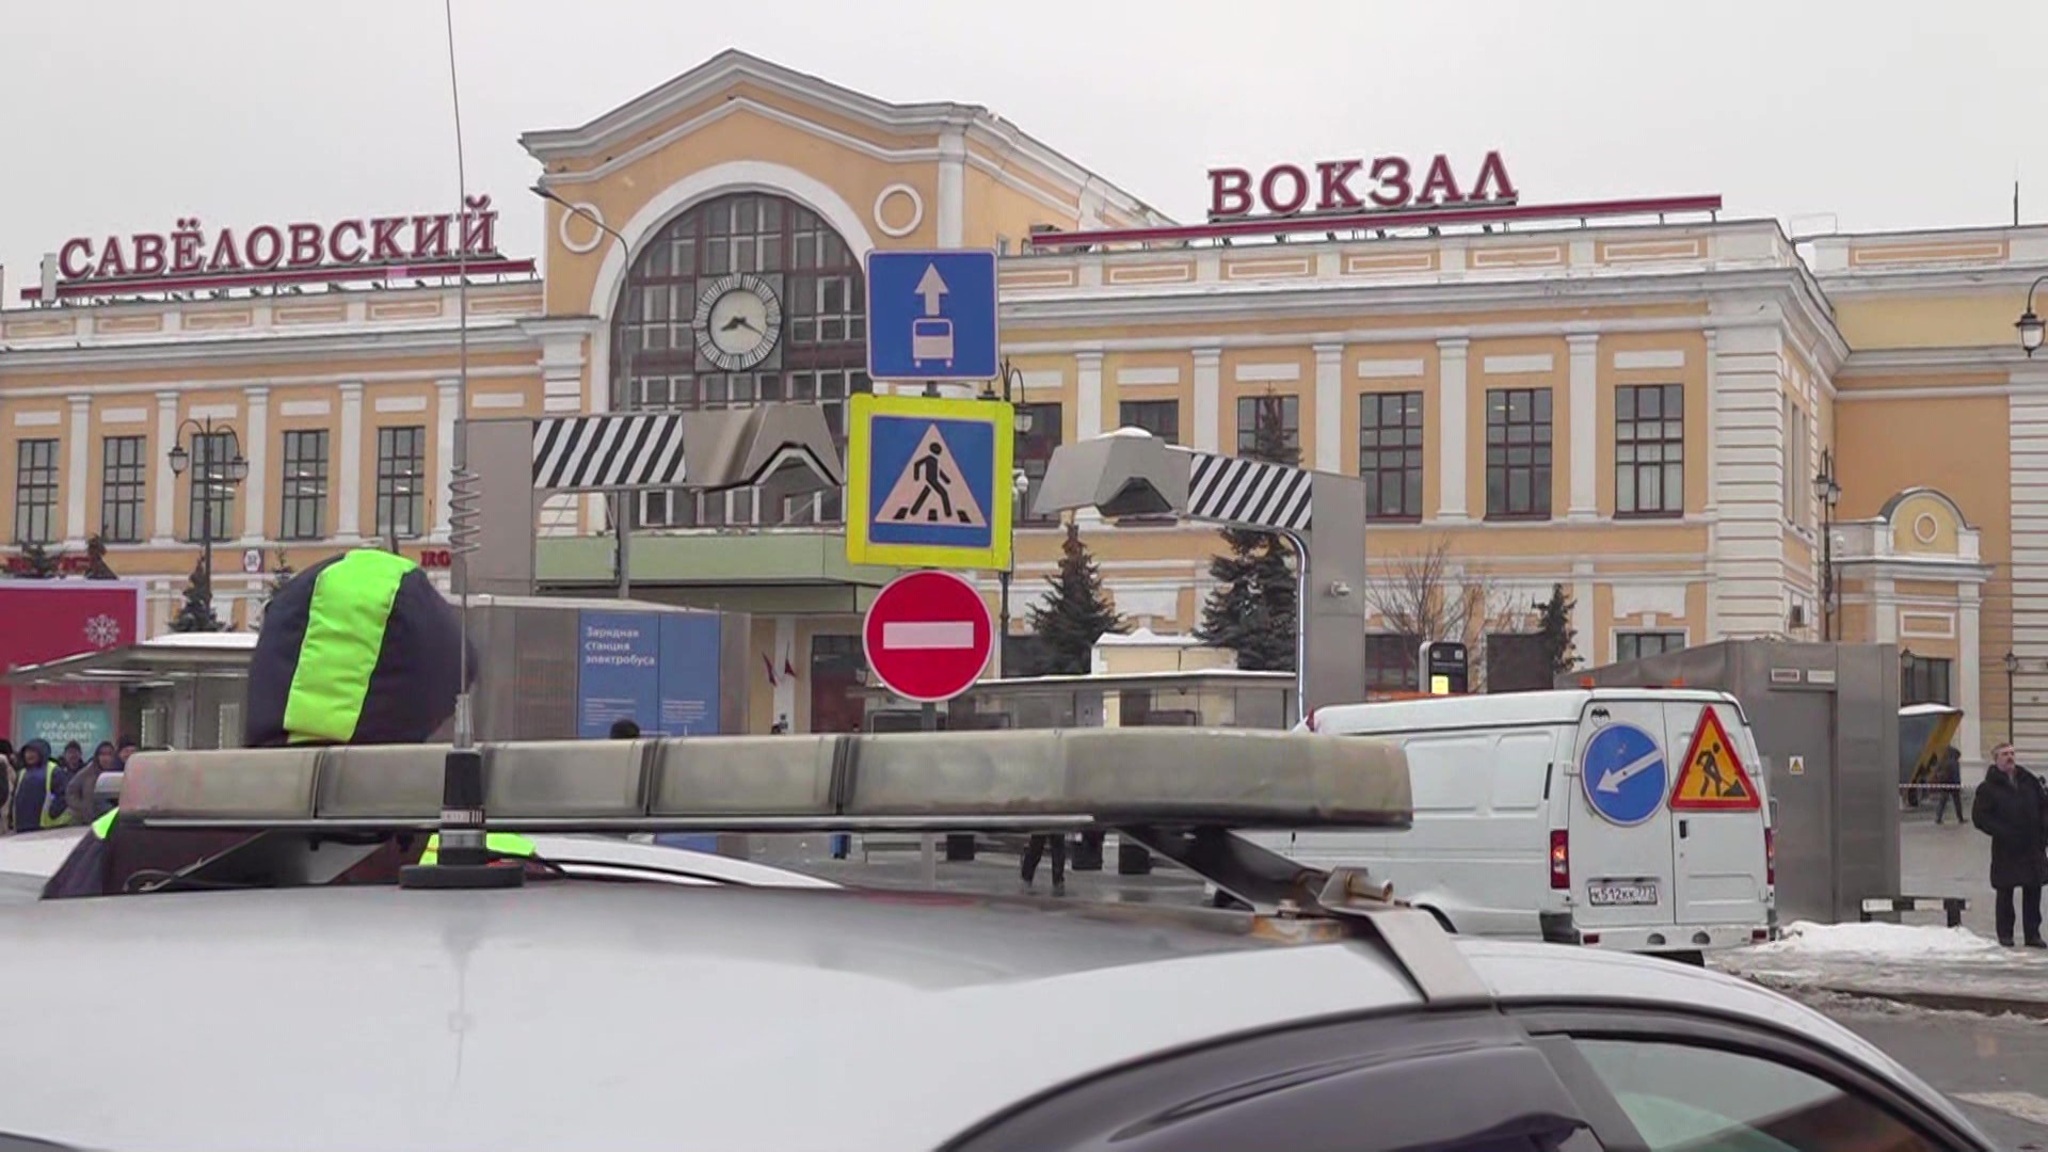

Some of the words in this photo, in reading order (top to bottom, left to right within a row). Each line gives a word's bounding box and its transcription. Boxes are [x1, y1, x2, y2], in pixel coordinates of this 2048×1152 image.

[1208, 151, 1518, 217] ВОКЗАЛ
[60, 195, 497, 279] САВЁЛОВСКИЙ
[585, 640, 630, 652] станция
